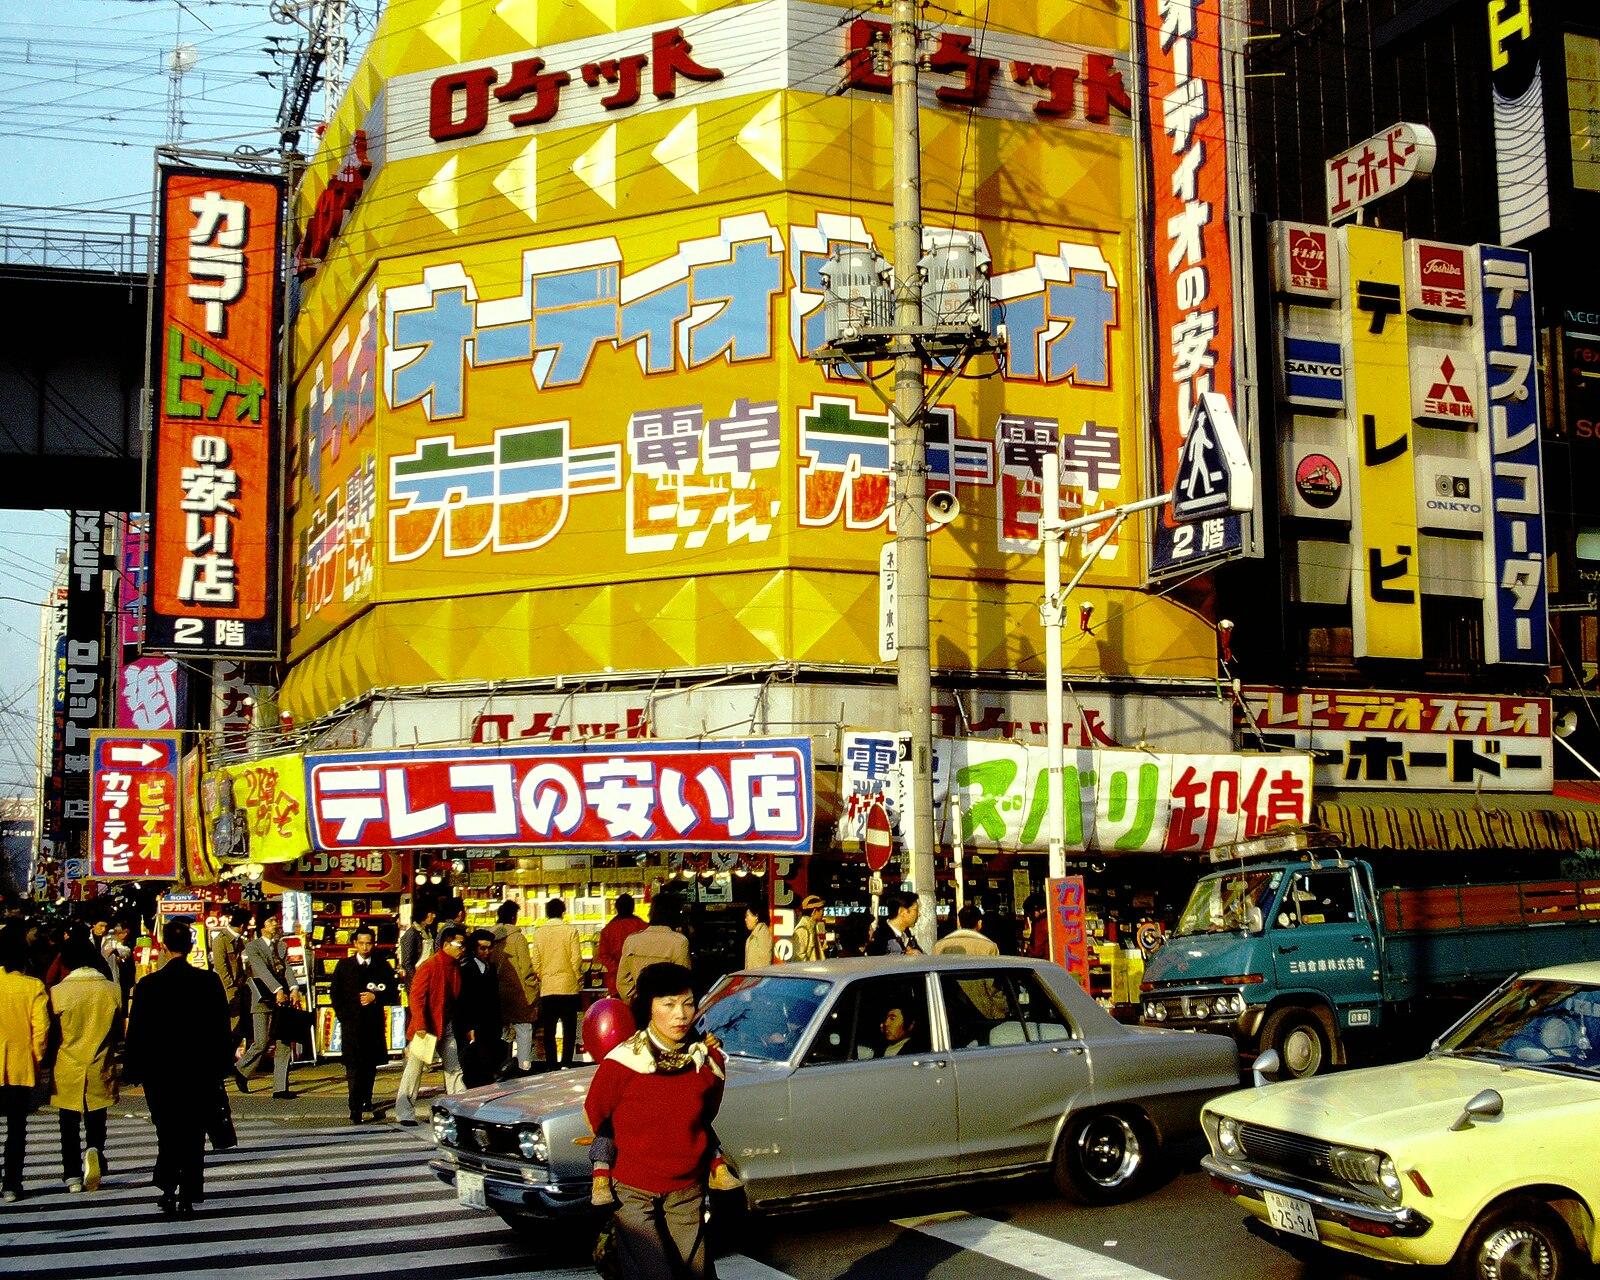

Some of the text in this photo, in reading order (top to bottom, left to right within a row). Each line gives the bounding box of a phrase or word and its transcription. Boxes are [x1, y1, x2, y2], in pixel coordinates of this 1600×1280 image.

[430, 27, 724, 144] ロケット
[1331, 128, 1415, 215] エーホード
[1158, 0, 1215, 462] オーディオの安い
[1423, 258, 1462, 277] Toshiba
[384, 211, 785, 422] オーディオ
[1421, 288, 1467, 310] 東芝
[165, 324, 265, 421] ビデオ
[1285, 360, 1343, 378] SANYO
[1424, 400, 1474, 418] 三菱電機
[626, 398, 781, 475] 電卓
[996, 413, 1121, 495] 電卓
[1357, 280, 1415, 605] テレビ
[1483, 259, 1544, 651] テープレコーダー
[1172, 519, 1224, 559] 2階
[1426, 498, 1482, 515] ONKYO
[173, 616, 247, 648] 2階
[101, 772, 132, 873] カラーテレビ
[138, 779, 168, 860] ビデオ
[319, 754, 798, 841] テレコの安い店
[161, 901, 202, 912] ビデオテレビ
[1278, 1209, 1315, 1237] 25-94
